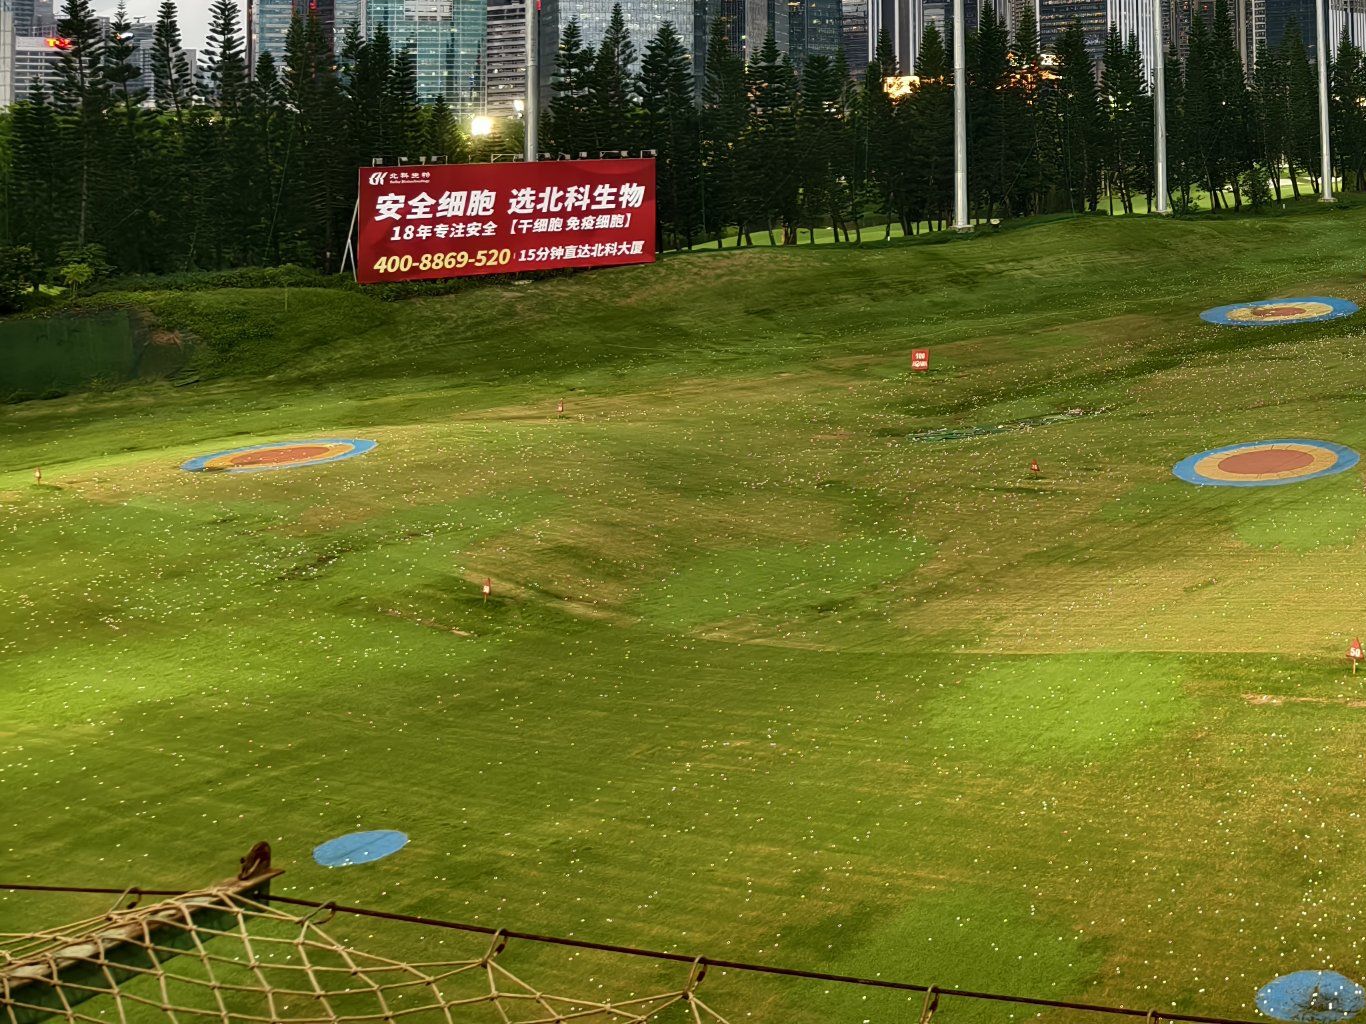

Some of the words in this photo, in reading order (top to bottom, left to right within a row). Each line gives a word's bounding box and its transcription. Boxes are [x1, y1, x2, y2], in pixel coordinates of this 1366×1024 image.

[374, 189, 497, 221] 安全细胞
[507, 182, 646, 215] 选北科生物
[390, 221, 498, 241] 18年专注安全
[373, 248, 511, 274] 400-8869-520
[518, 240, 645, 262] 15分钟直达北科大厦
[1350, 647, 1361, 657] 50
